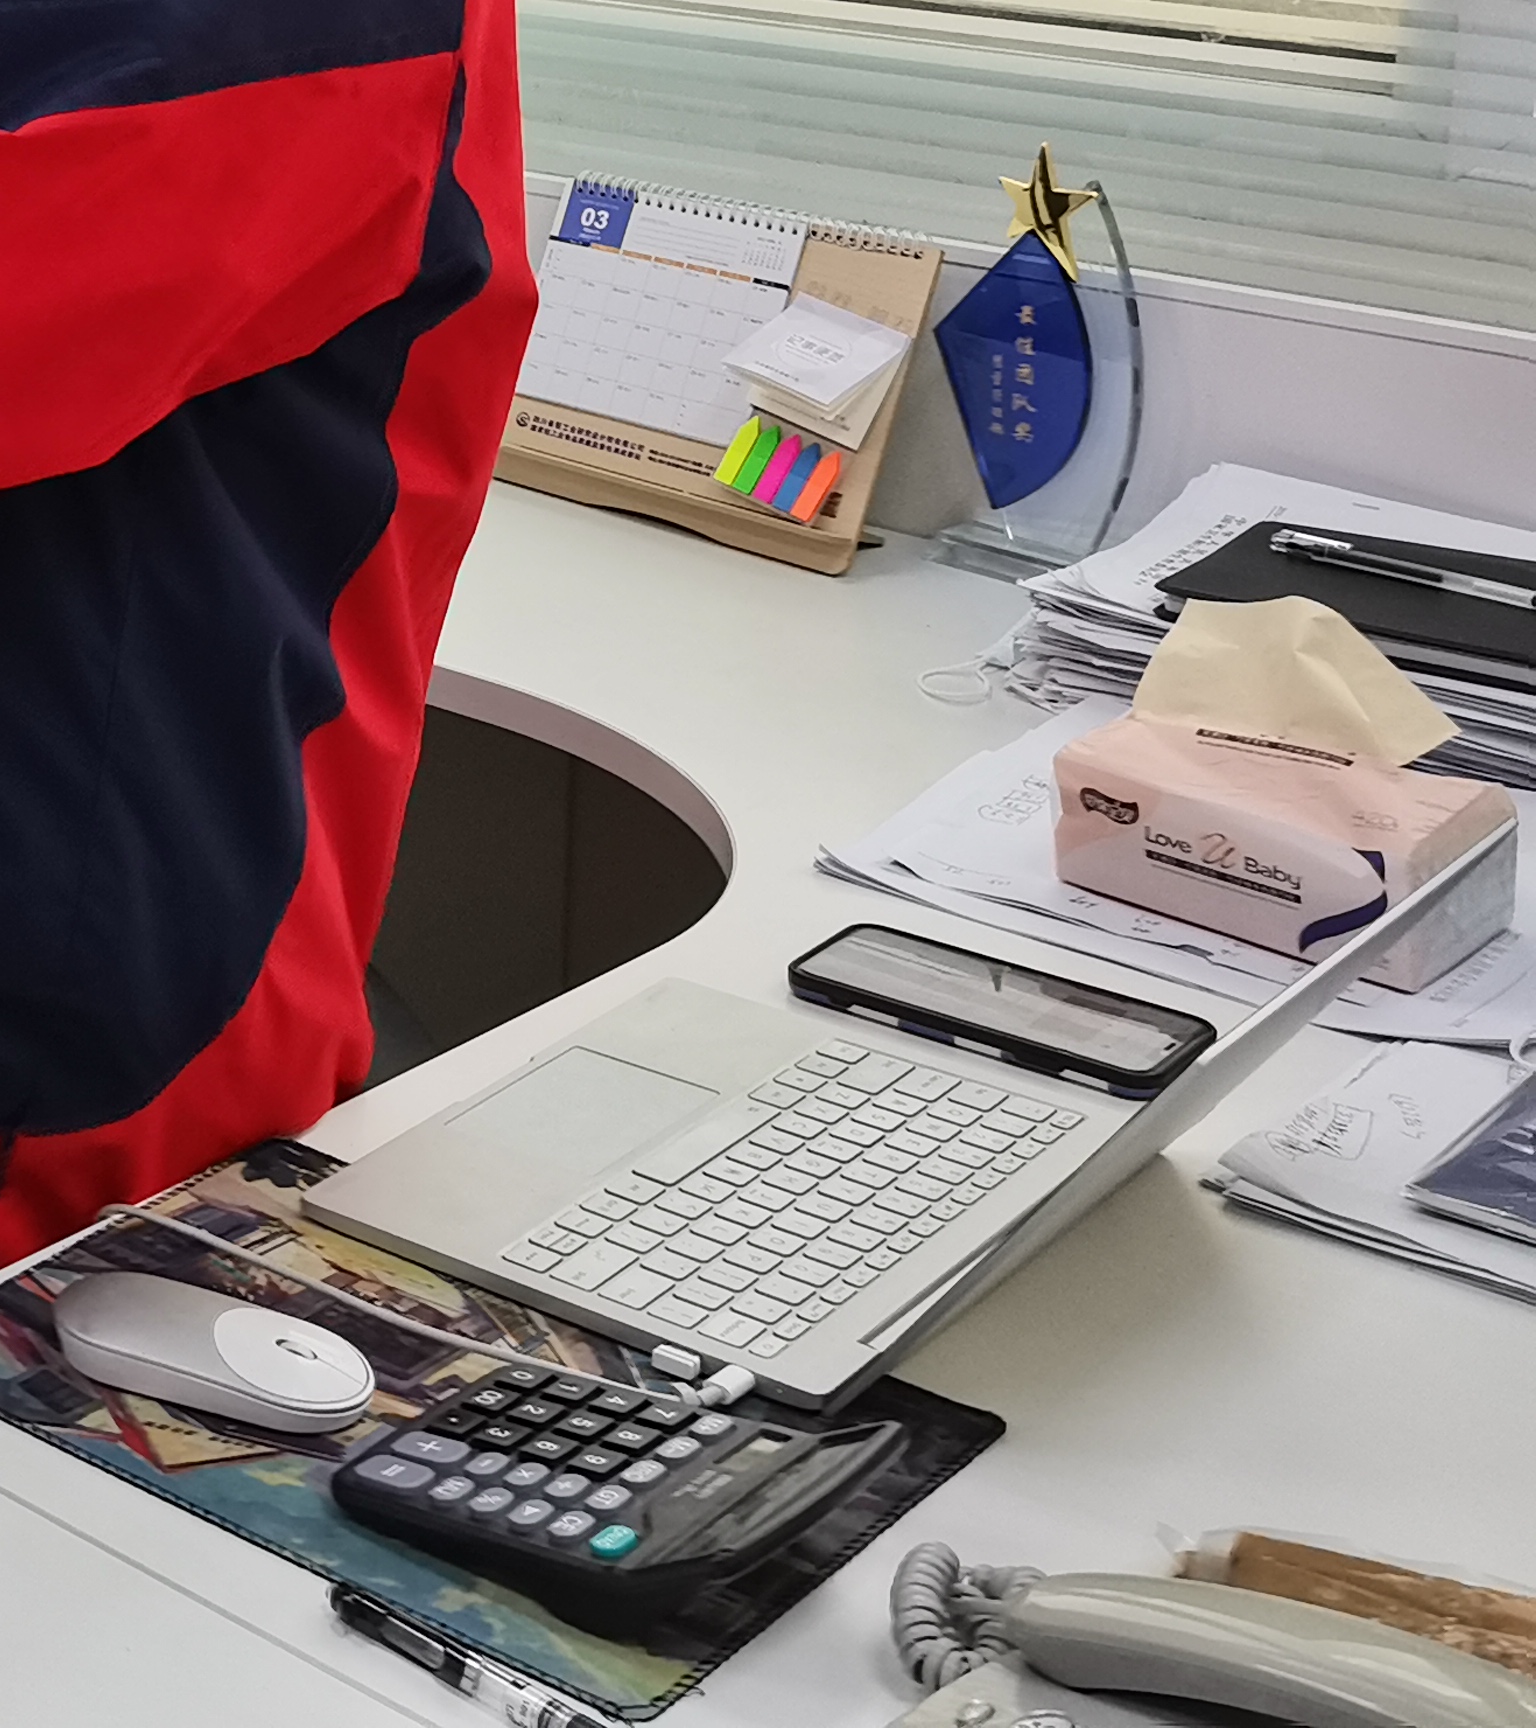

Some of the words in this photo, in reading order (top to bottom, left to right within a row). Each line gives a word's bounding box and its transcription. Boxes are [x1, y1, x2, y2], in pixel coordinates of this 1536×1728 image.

[580, 207, 610, 230] 03
[1144, 825, 1193, 855] Love
[1243, 855, 1303, 891] Baby
[511, 1370, 534, 1382] 0
[558, 1380, 580, 1393] 1
[472, 1388, 503, 1406] 00
[605, 1394, 625, 1406] 4
[525, 1404, 546, 1415] 2
[655, 1407, 677, 1420] 7
[571, 1417, 593, 1430] 5
[488, 1426, 510, 1439] 3
[618, 1430, 640, 1442] 8
[536, 1439, 559, 1452] 6
[584, 1453, 608, 1466] 9
